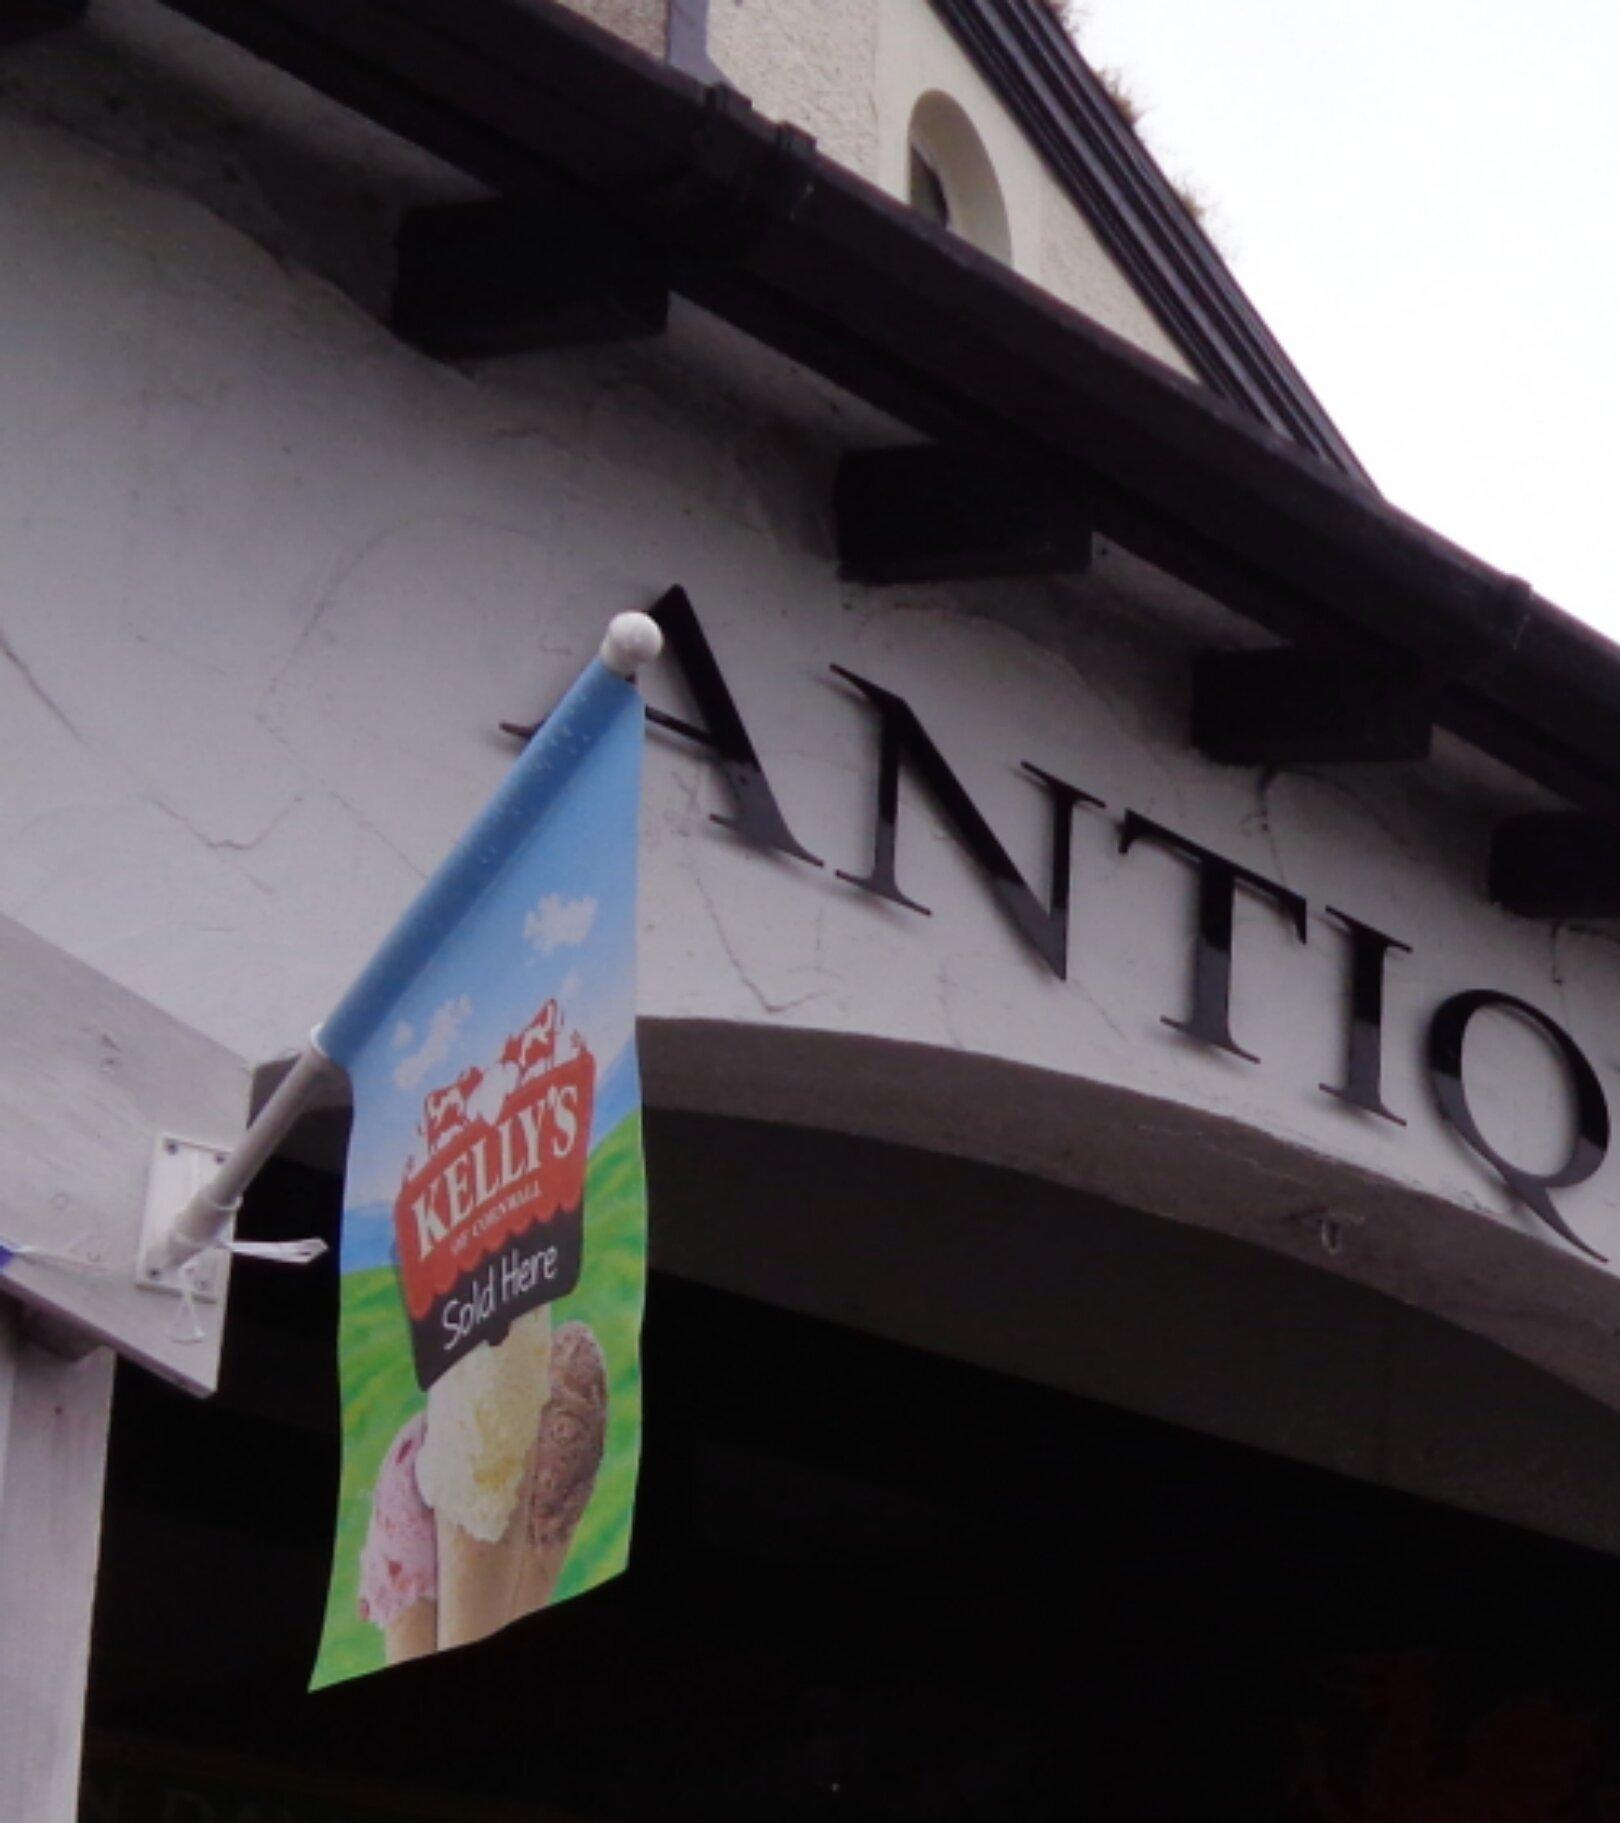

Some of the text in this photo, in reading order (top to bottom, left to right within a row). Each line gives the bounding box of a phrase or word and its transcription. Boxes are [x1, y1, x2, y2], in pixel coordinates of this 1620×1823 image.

[412, 1084, 578, 1261] KELLY'S
[442, 1244, 558, 1351] Sold Here
